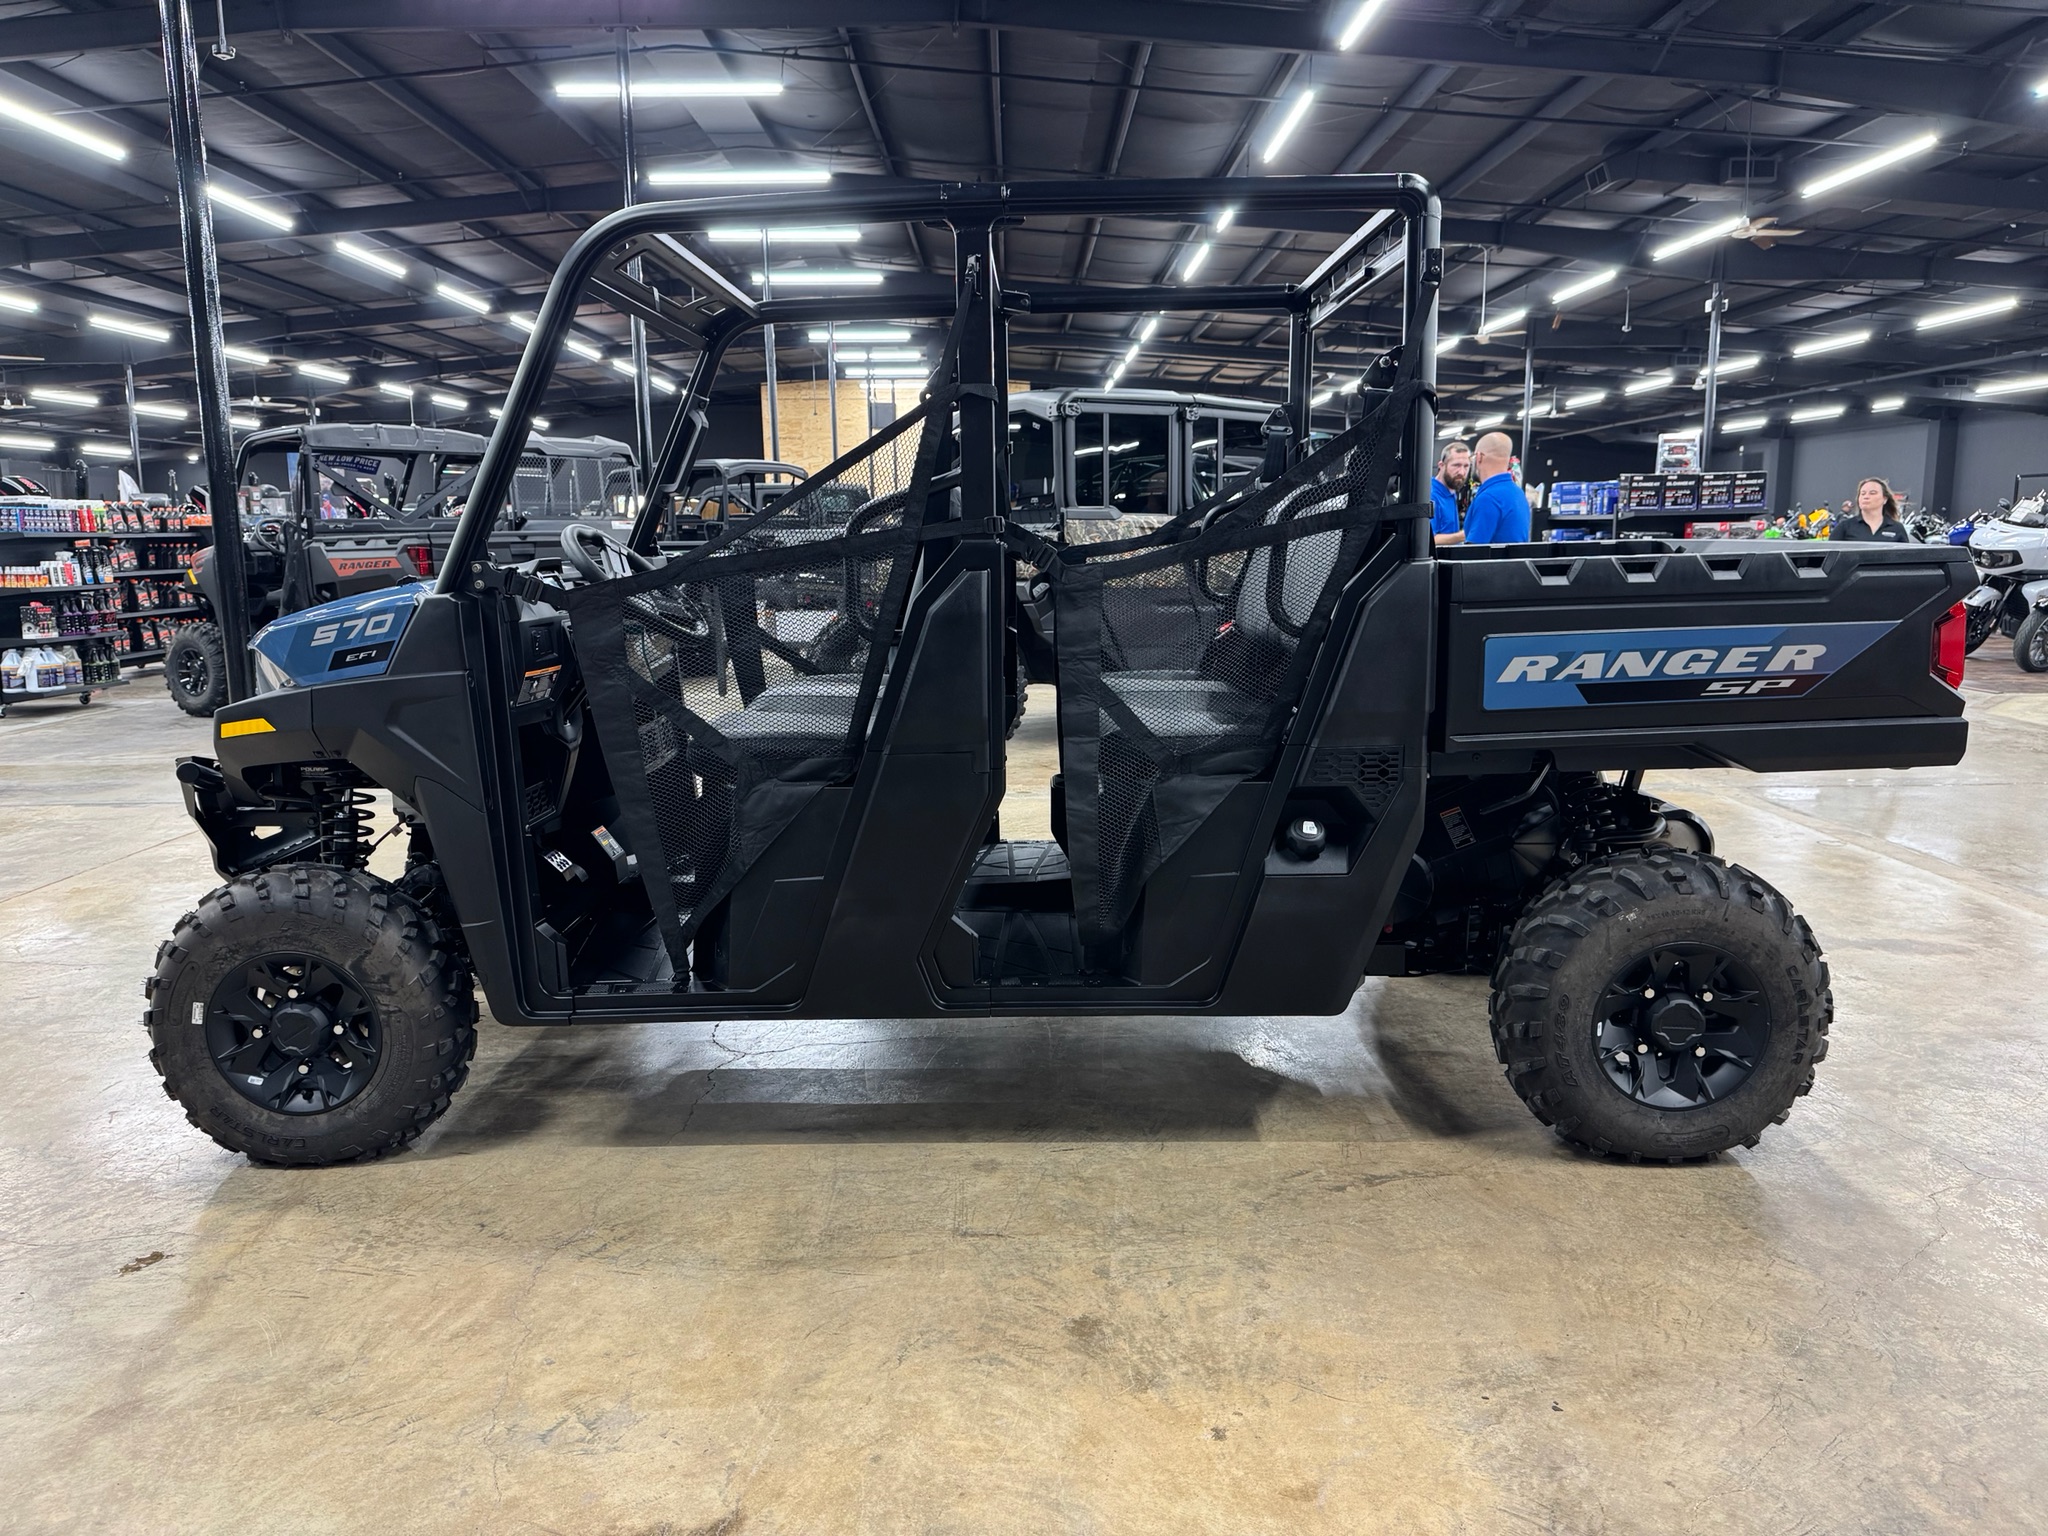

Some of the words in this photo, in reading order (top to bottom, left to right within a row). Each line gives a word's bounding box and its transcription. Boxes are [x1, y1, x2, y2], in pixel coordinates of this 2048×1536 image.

[336, 455, 354, 463] LOW
[354, 456, 379, 468] PRICE
[339, 560, 392, 570] RANGER
[310, 613, 395, 647] 570
[345, 650, 377, 662] EFI
[1496, 644, 1827, 684] RANGER
[1700, 678, 1797, 697] SP
[1553, 993, 1580, 1087] AT489
[208, 1105, 306, 1149] CARLSTAR
